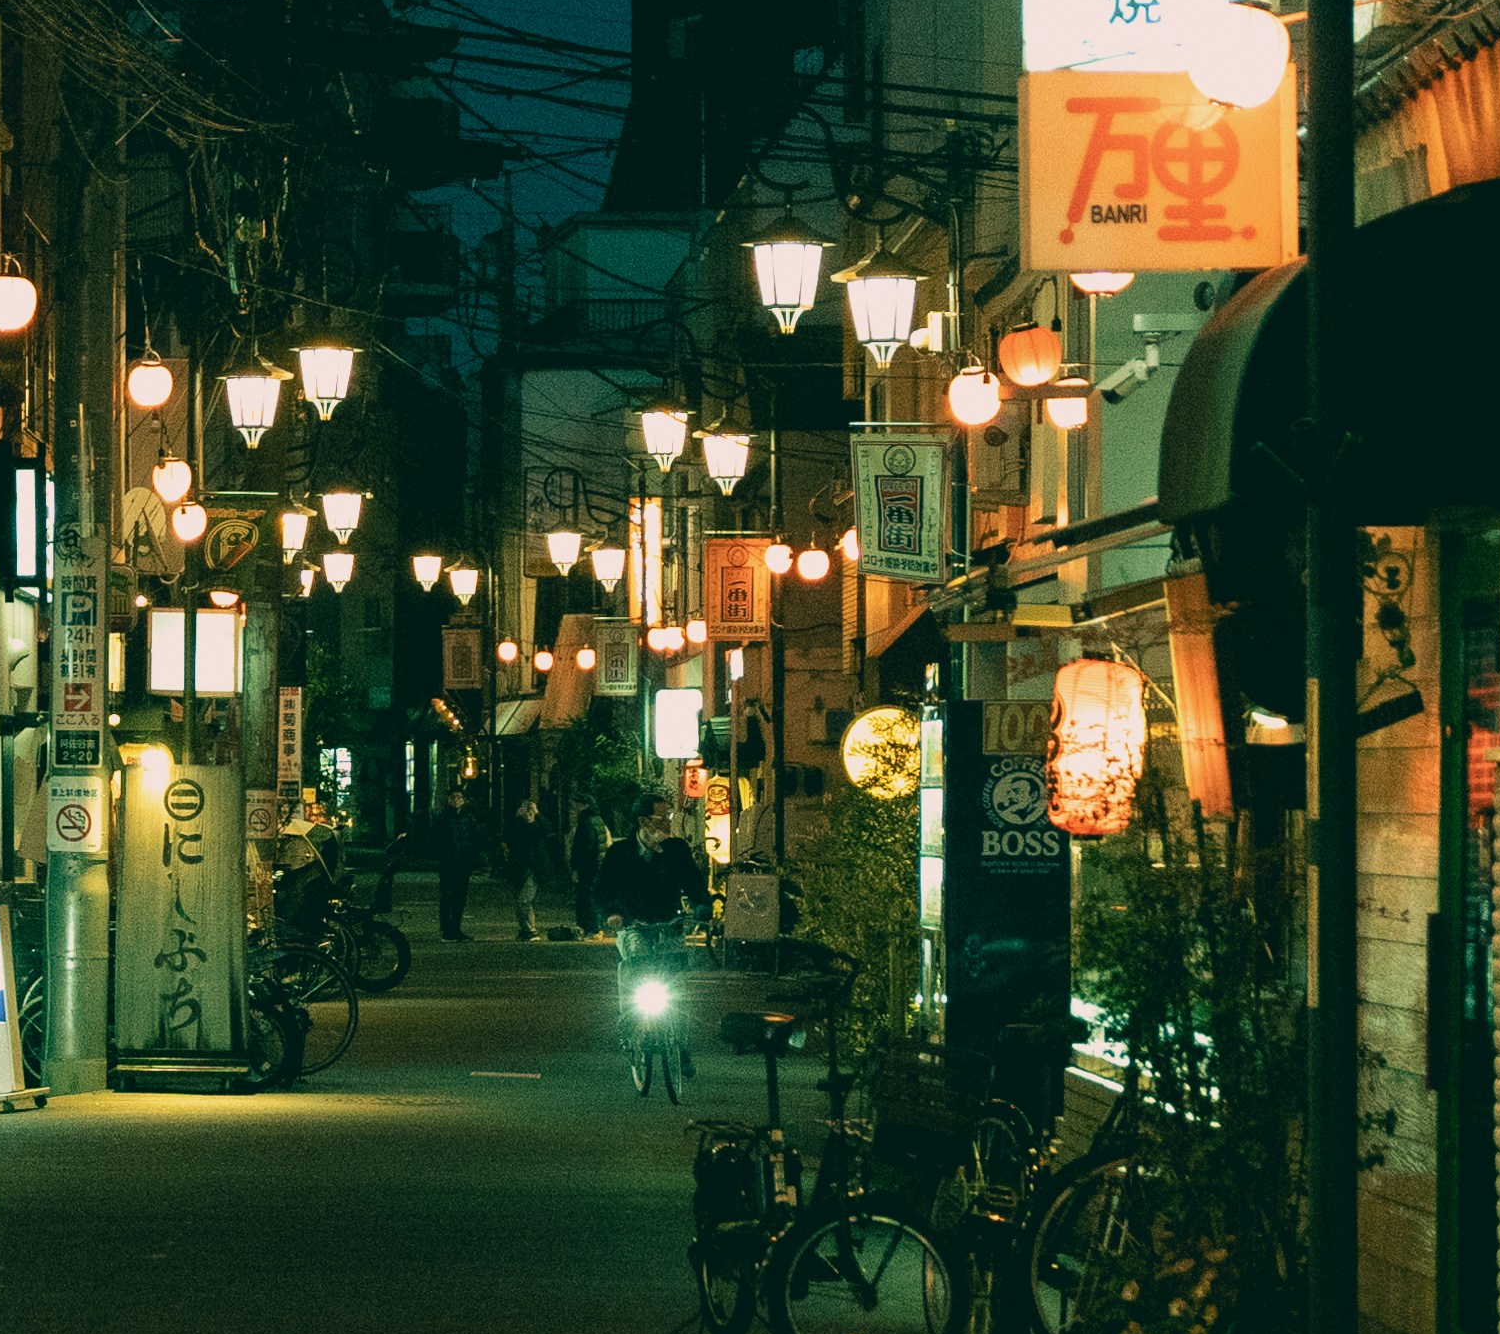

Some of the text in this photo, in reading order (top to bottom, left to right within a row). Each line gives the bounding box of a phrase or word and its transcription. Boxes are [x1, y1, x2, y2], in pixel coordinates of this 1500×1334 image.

[1091, 203, 1148, 225] BANRI
[884, 495, 917, 549] 一番街
[62, 750, 94, 763] 2-20
[981, 830, 1061, 857] BOSS
